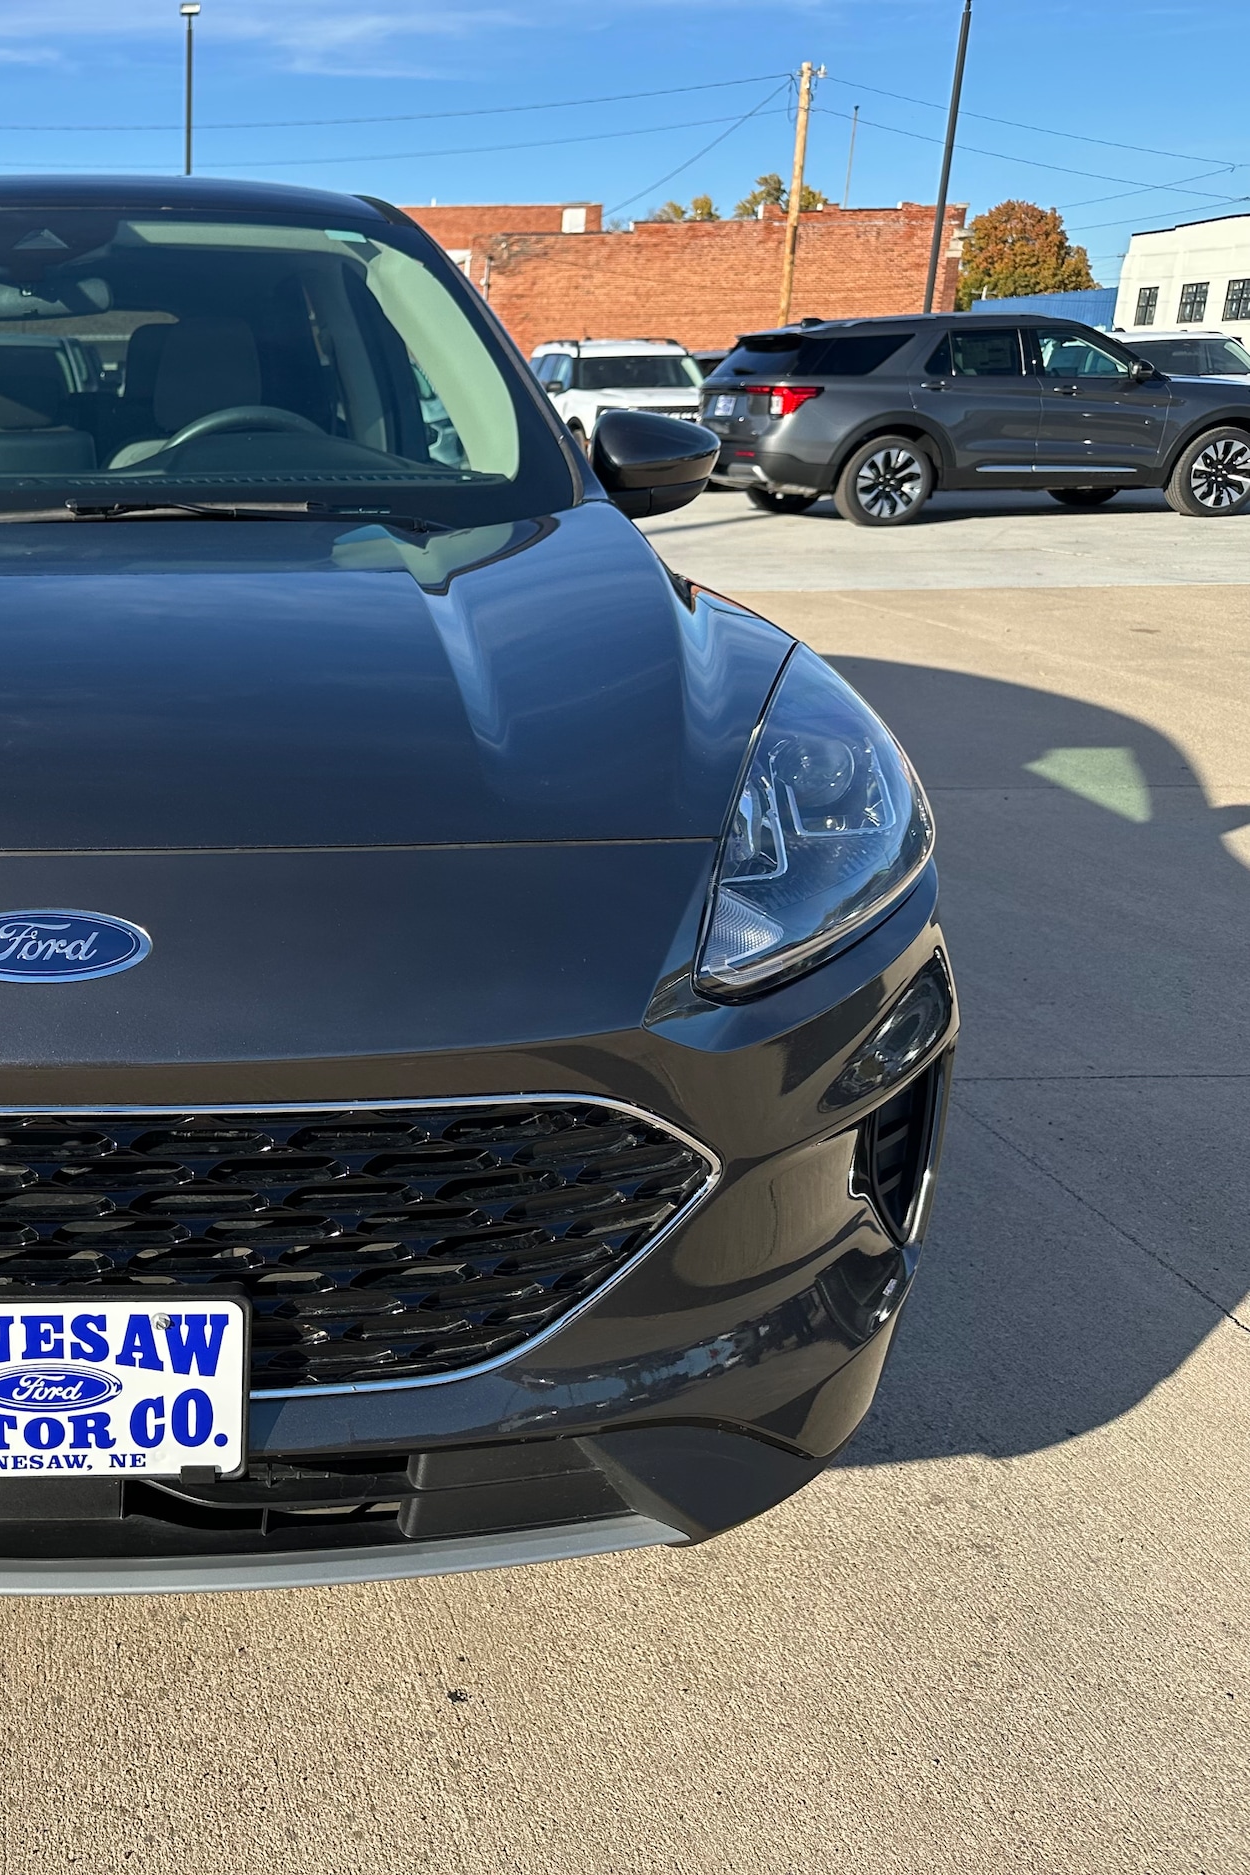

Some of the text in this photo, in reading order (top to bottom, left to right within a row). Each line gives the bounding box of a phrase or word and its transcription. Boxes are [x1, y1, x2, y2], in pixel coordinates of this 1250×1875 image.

[12, 1373, 84, 1402] Ford
[129, 1387, 229, 1448] CO.
[108, 1452, 147, 1469] NE
